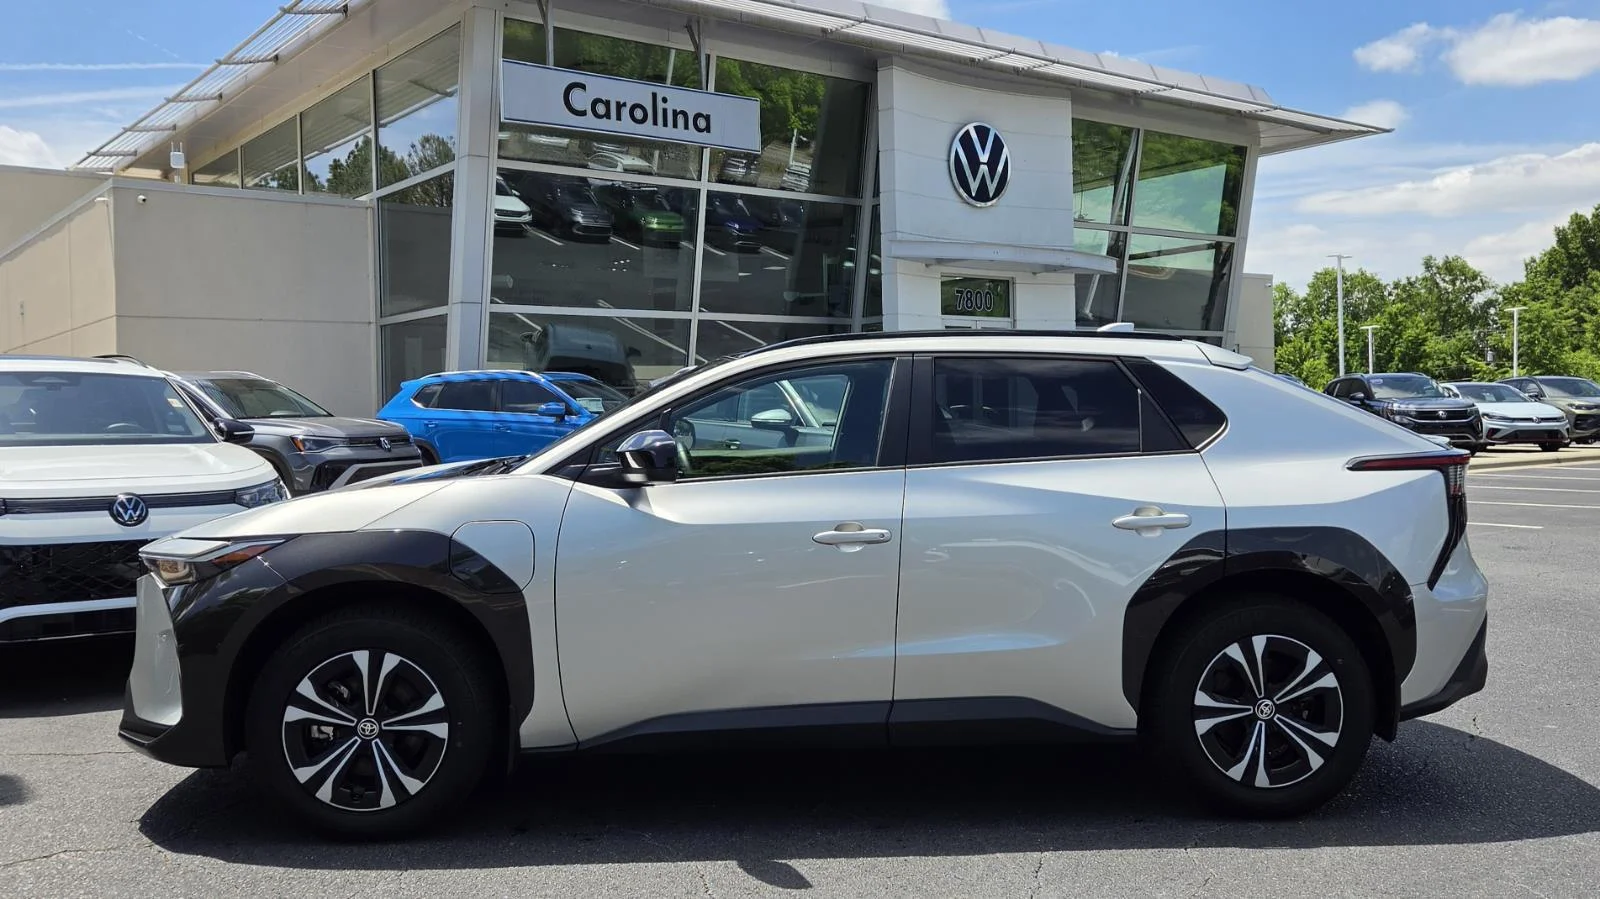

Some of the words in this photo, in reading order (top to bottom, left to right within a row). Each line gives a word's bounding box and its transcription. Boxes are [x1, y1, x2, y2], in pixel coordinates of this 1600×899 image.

[562, 81, 712, 134] Carolina
[952, 123, 1010, 200] VW
[954, 288, 994, 312] 7800
